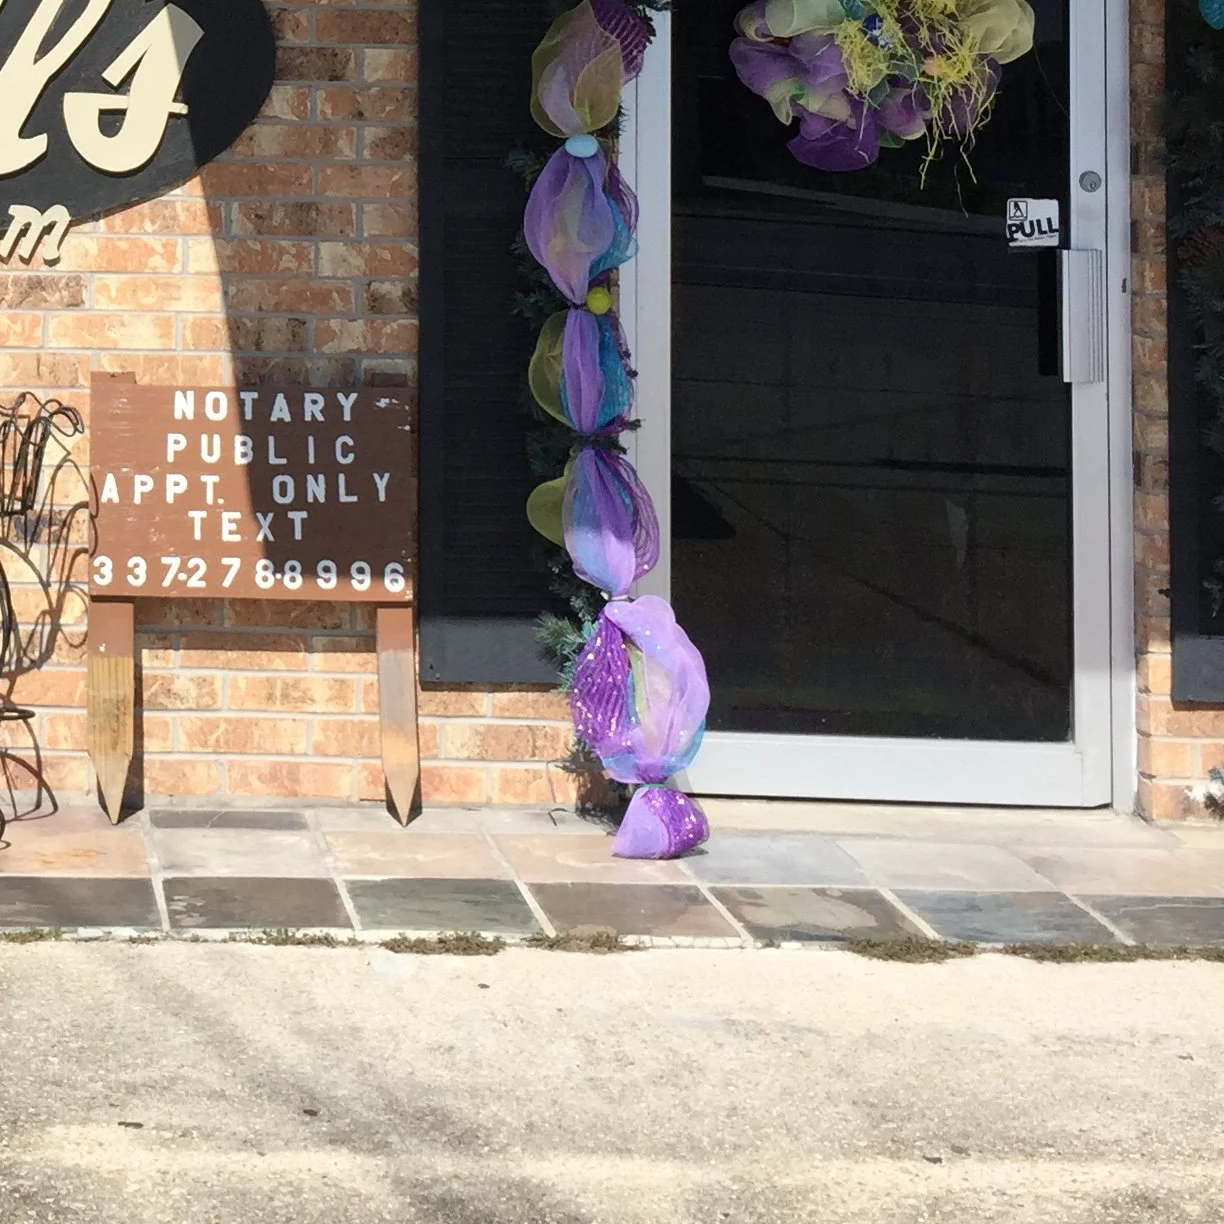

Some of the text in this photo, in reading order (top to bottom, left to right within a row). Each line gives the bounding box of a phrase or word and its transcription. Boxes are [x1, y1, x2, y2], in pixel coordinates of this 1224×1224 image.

[1007, 217, 1059, 243] PULL
[174, 390, 358, 422] NOTARY
[167, 433, 355, 465] PUBLIC
[100, 472, 390, 505] APPT. ONLY
[188, 510, 308, 542] TEXT
